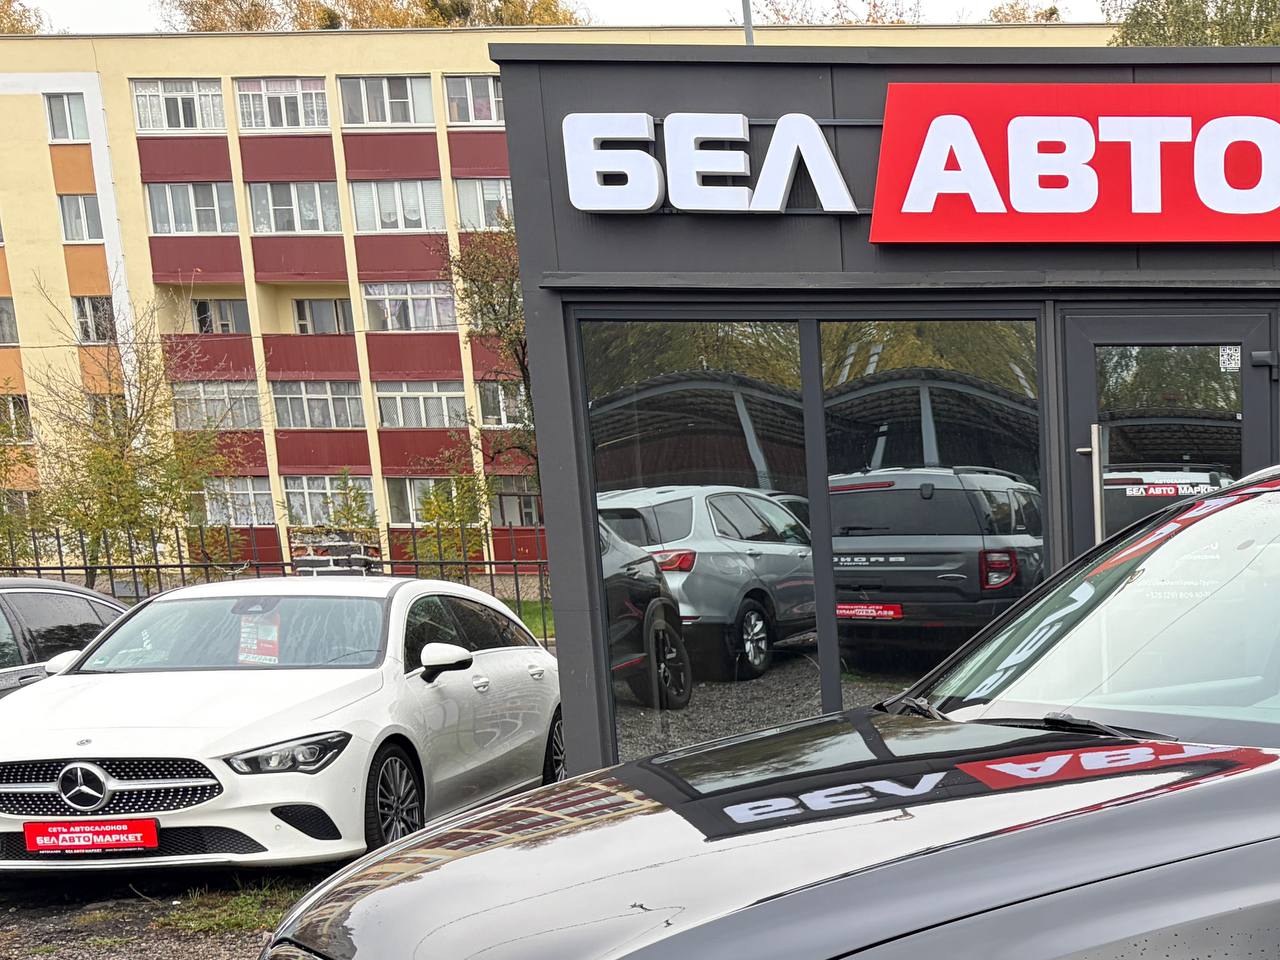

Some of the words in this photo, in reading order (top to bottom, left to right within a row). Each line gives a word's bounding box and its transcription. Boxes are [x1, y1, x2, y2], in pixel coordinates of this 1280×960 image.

[561, 112, 859, 214] БЕЛ
[1126, 487, 1146, 496] БЕЛ
[1148, 486, 1175, 496] АВТО
[69, 824, 128, 832] АВТОСАЛОНОВ
[36, 836, 58, 845] БЕЛ
[60, 834, 92, 844] АВТО
[93, 833, 143, 843] МАРКЕТ
